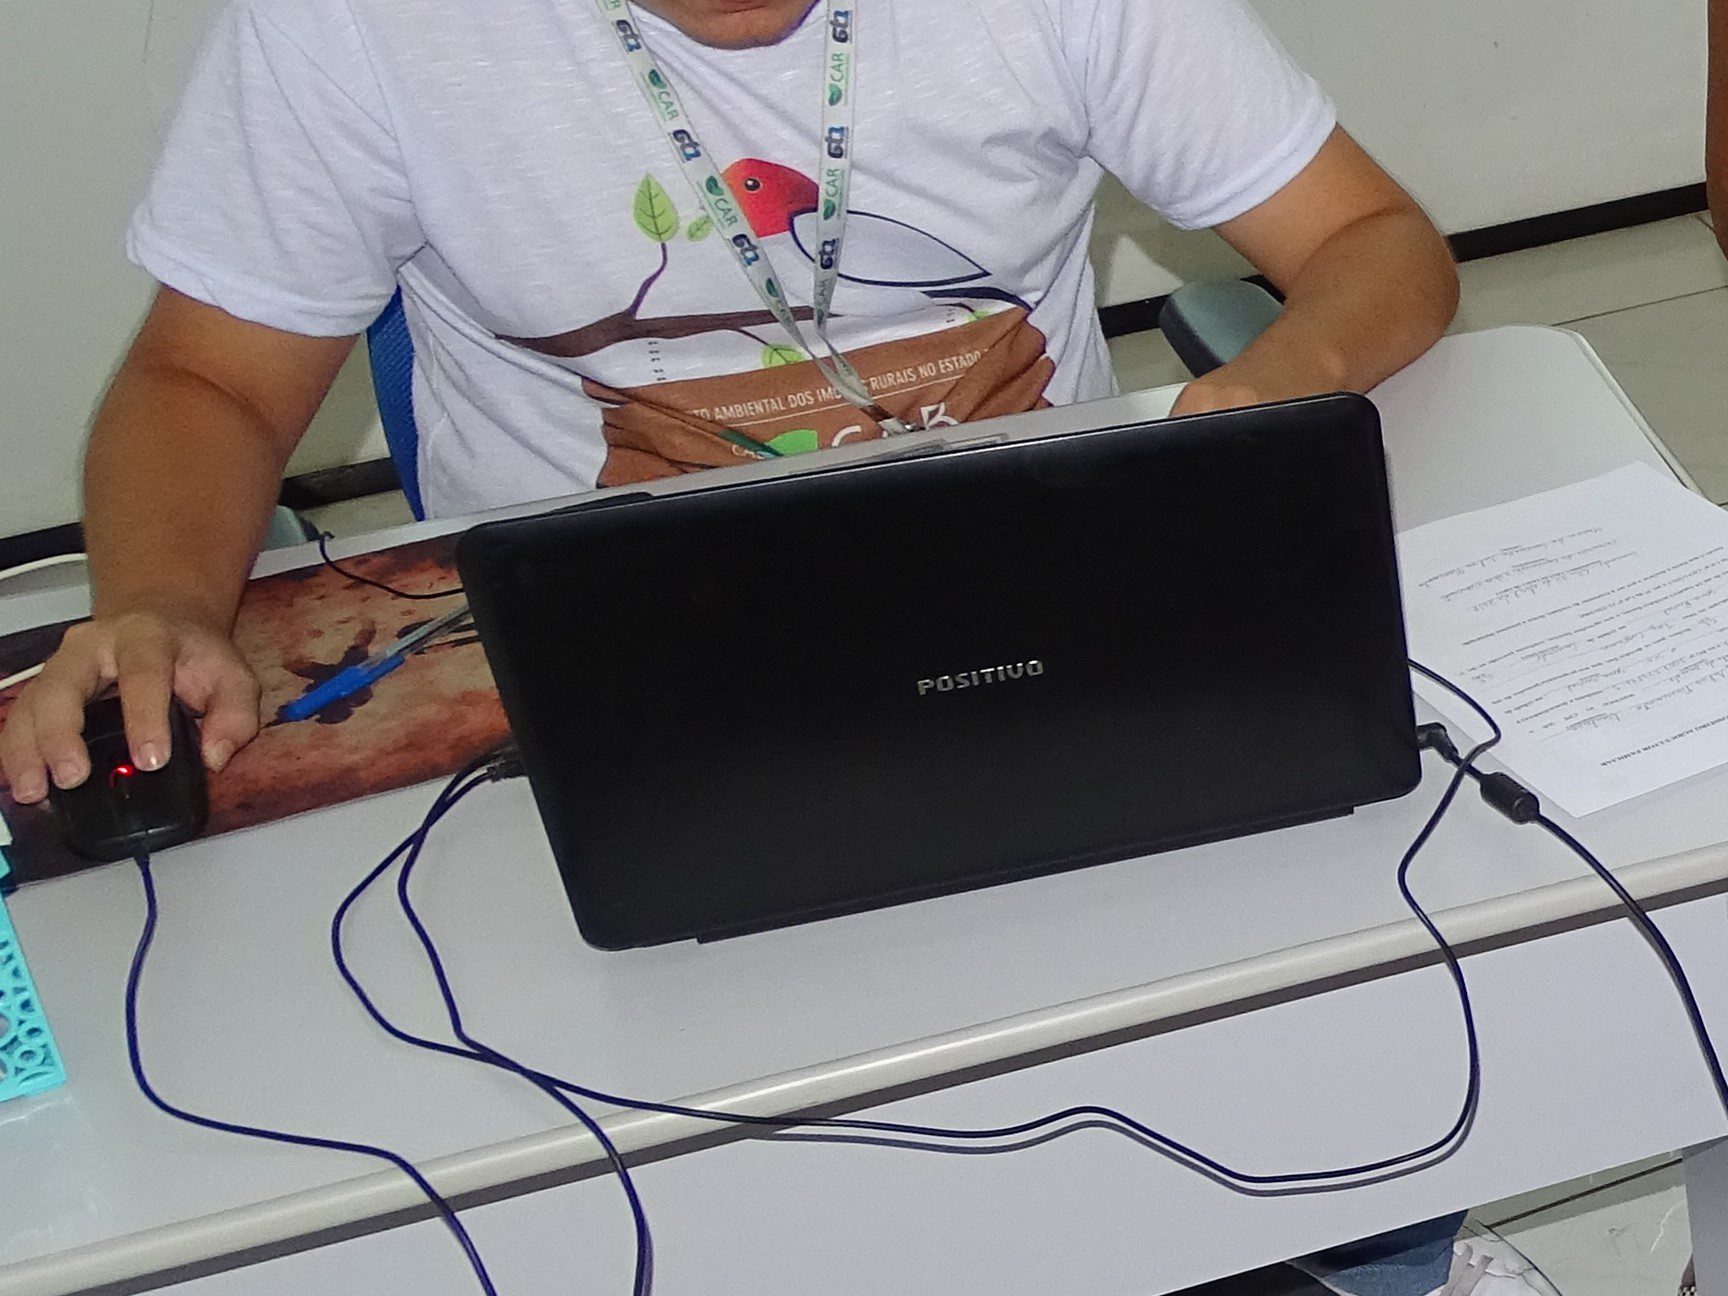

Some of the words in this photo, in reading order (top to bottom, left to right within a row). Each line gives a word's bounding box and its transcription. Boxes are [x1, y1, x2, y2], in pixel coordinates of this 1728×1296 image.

[657, 90, 680, 122] CAR
[714, 197, 738, 228] CAR
[713, 398, 784, 422] AMBIENTAL
[789, 392, 814, 408] DOS
[869, 370, 918, 391] RURAIS
[918, 363, 936, 379] NO
[916, 659, 1045, 696] POSITIVO
